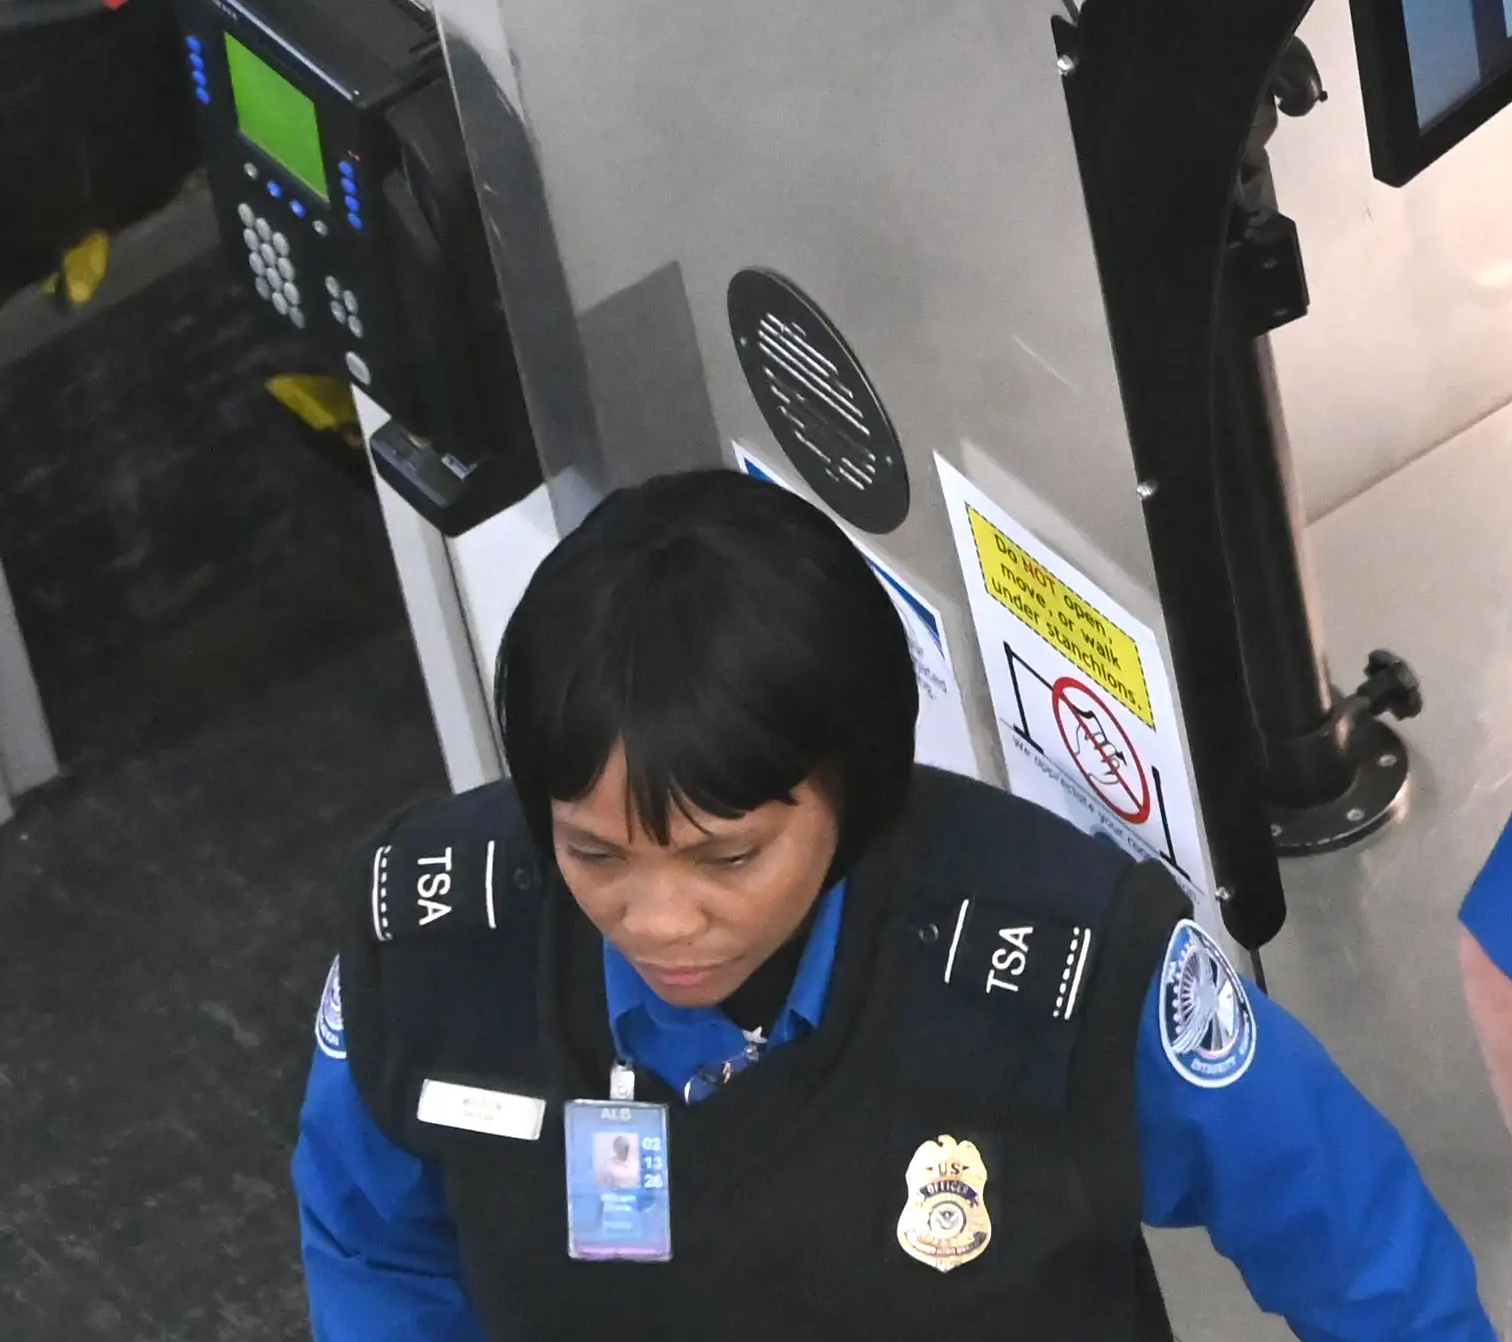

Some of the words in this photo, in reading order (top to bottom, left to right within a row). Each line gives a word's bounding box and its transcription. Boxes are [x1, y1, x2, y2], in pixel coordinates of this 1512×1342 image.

[993, 533, 1018, 564] Do
[1023, 558, 1057, 596] NOT
[991, 577, 1041, 625] under
[1046, 621, 1143, 711] stanchions.
[1058, 612, 1074, 633] or
[1081, 630, 1121, 671] walk
[418, 846, 452, 927] TSA
[986, 926, 1034, 995] TSA
[600, 1107, 632, 1122] ALB
[643, 1157, 663, 1170] 13
[937, 1162, 962, 1177] US
